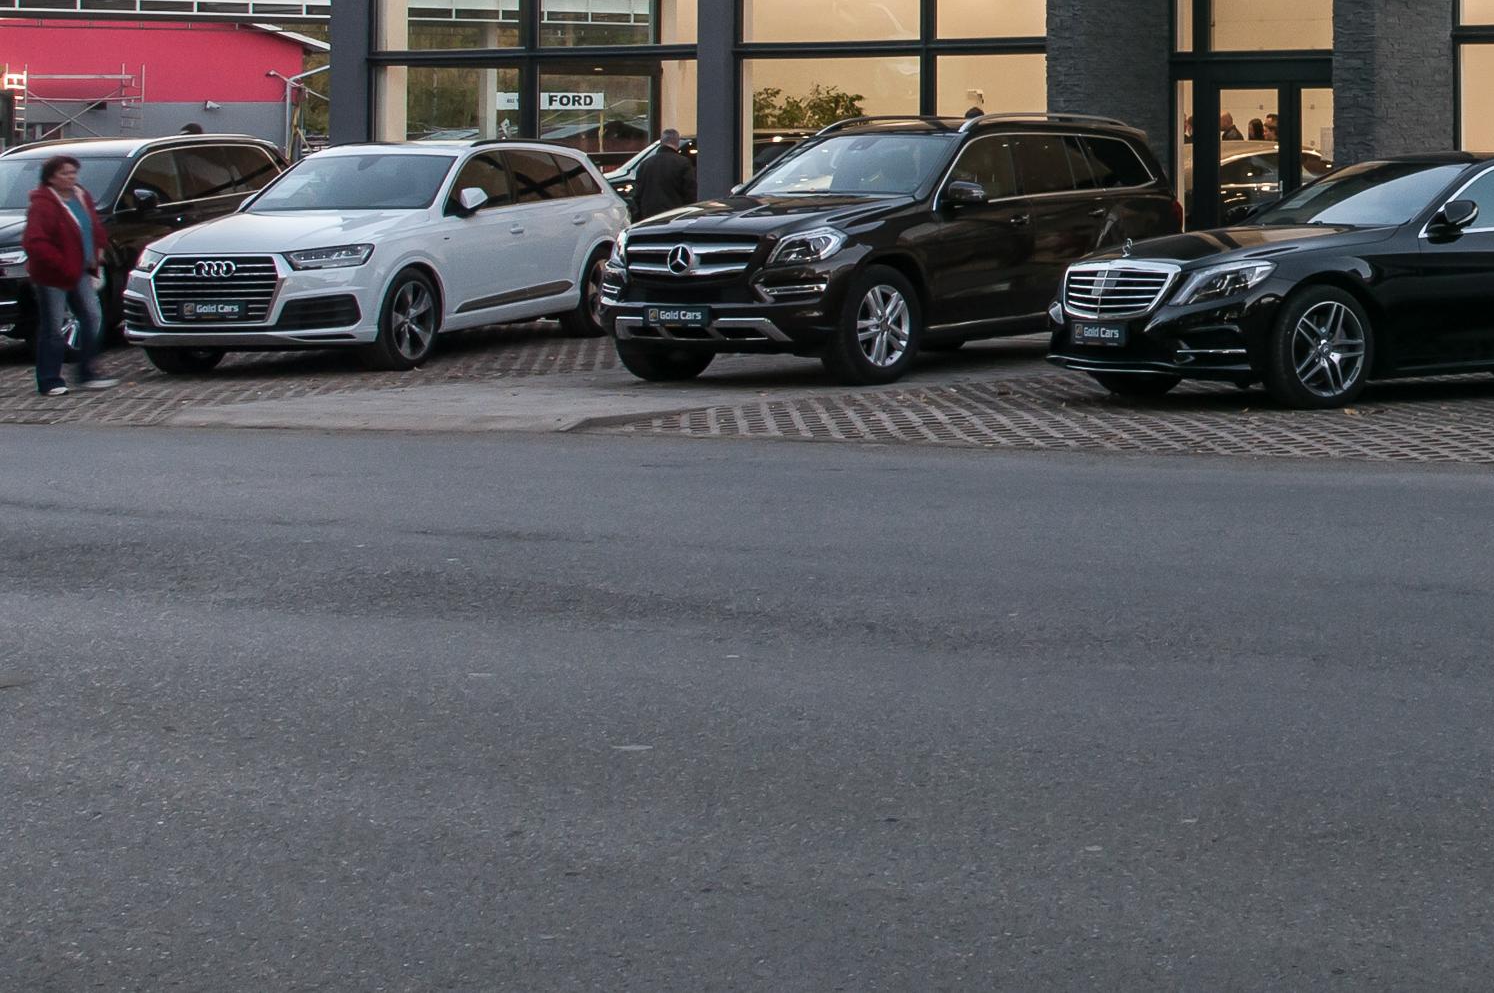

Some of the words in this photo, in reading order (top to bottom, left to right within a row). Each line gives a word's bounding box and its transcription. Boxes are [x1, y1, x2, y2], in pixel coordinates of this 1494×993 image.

[548, 95, 594, 106] FORD
[196, 304, 217, 313] Gold
[218, 304, 239, 313] Cars
[659, 310, 679, 320] Gold
[680, 310, 702, 320] Cars
[1083, 327, 1099, 337] Gold
[1100, 328, 1119, 338] Cars
